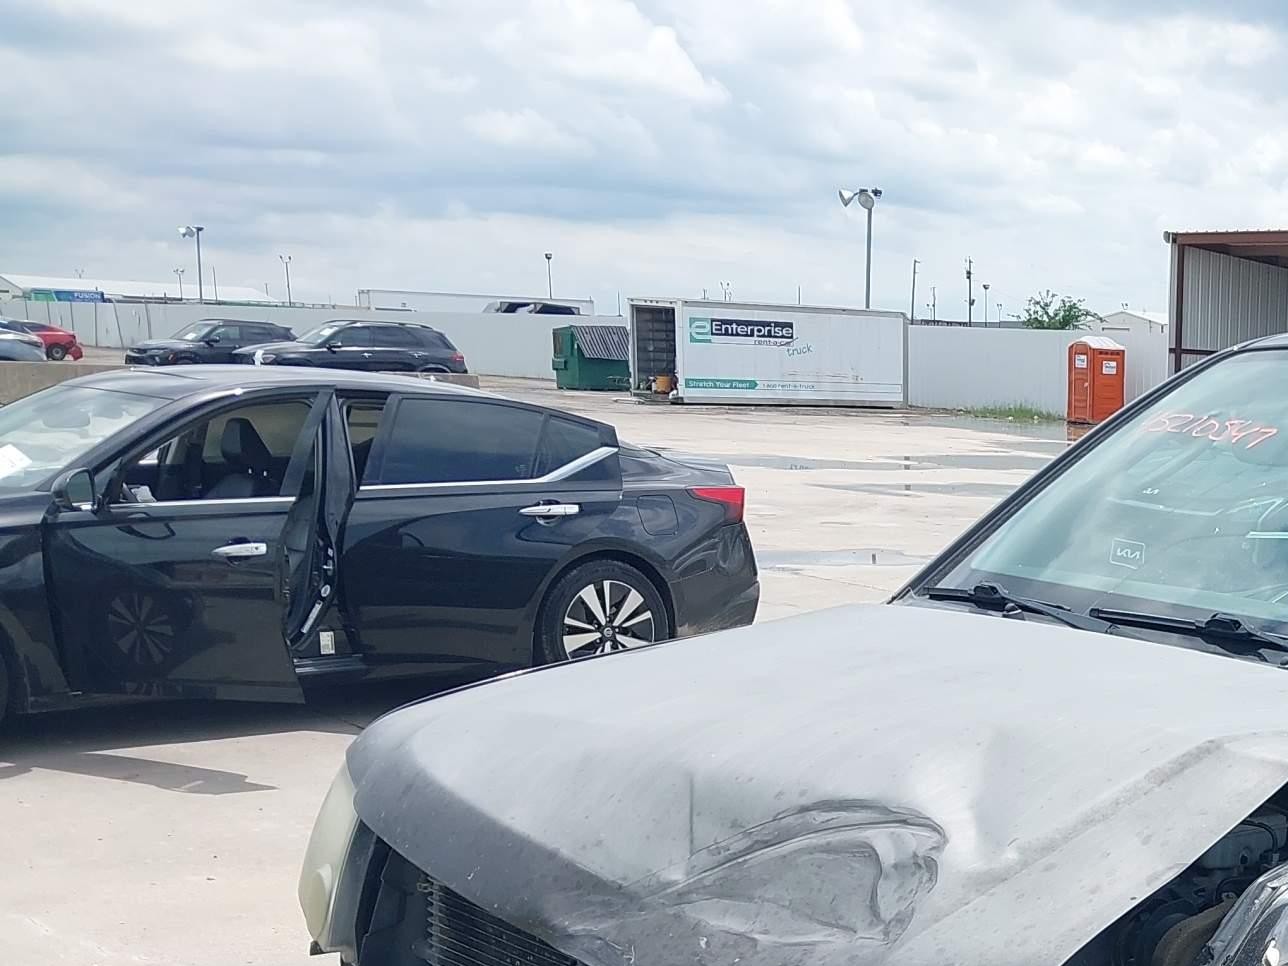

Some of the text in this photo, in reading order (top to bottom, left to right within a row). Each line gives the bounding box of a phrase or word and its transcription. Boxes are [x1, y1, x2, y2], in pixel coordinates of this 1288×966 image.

[711, 321, 793, 337] Enterprise
[786, 344, 813, 357] truck
[688, 380, 714, 388] Stretch
[732, 381, 751, 389] Fleet
